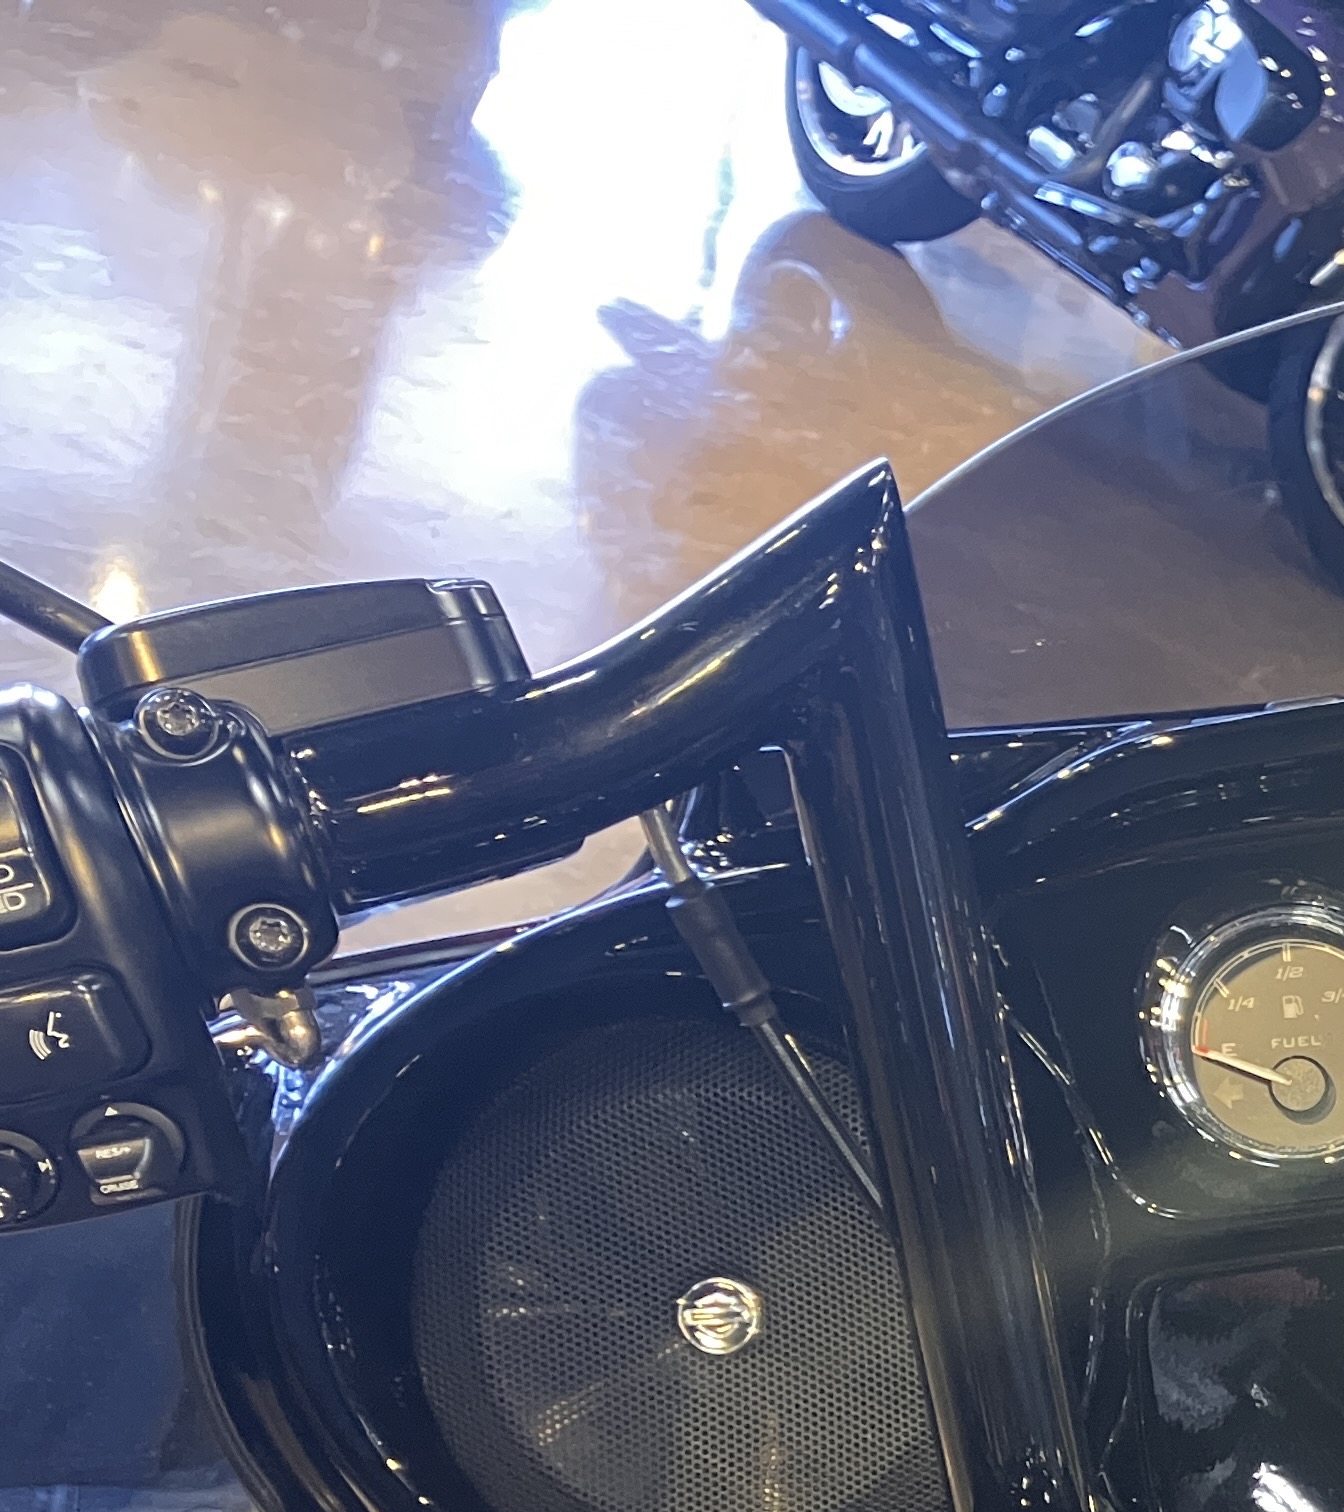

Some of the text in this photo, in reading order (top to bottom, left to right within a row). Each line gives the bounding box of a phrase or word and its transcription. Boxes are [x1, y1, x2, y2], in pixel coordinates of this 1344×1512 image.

[1275, 966, 1304, 981] 1/2
[1227, 996, 1255, 1012] 1/4
[1271, 1036, 1321, 1049] FUEL
[1221, 1043, 1237, 1057] E
